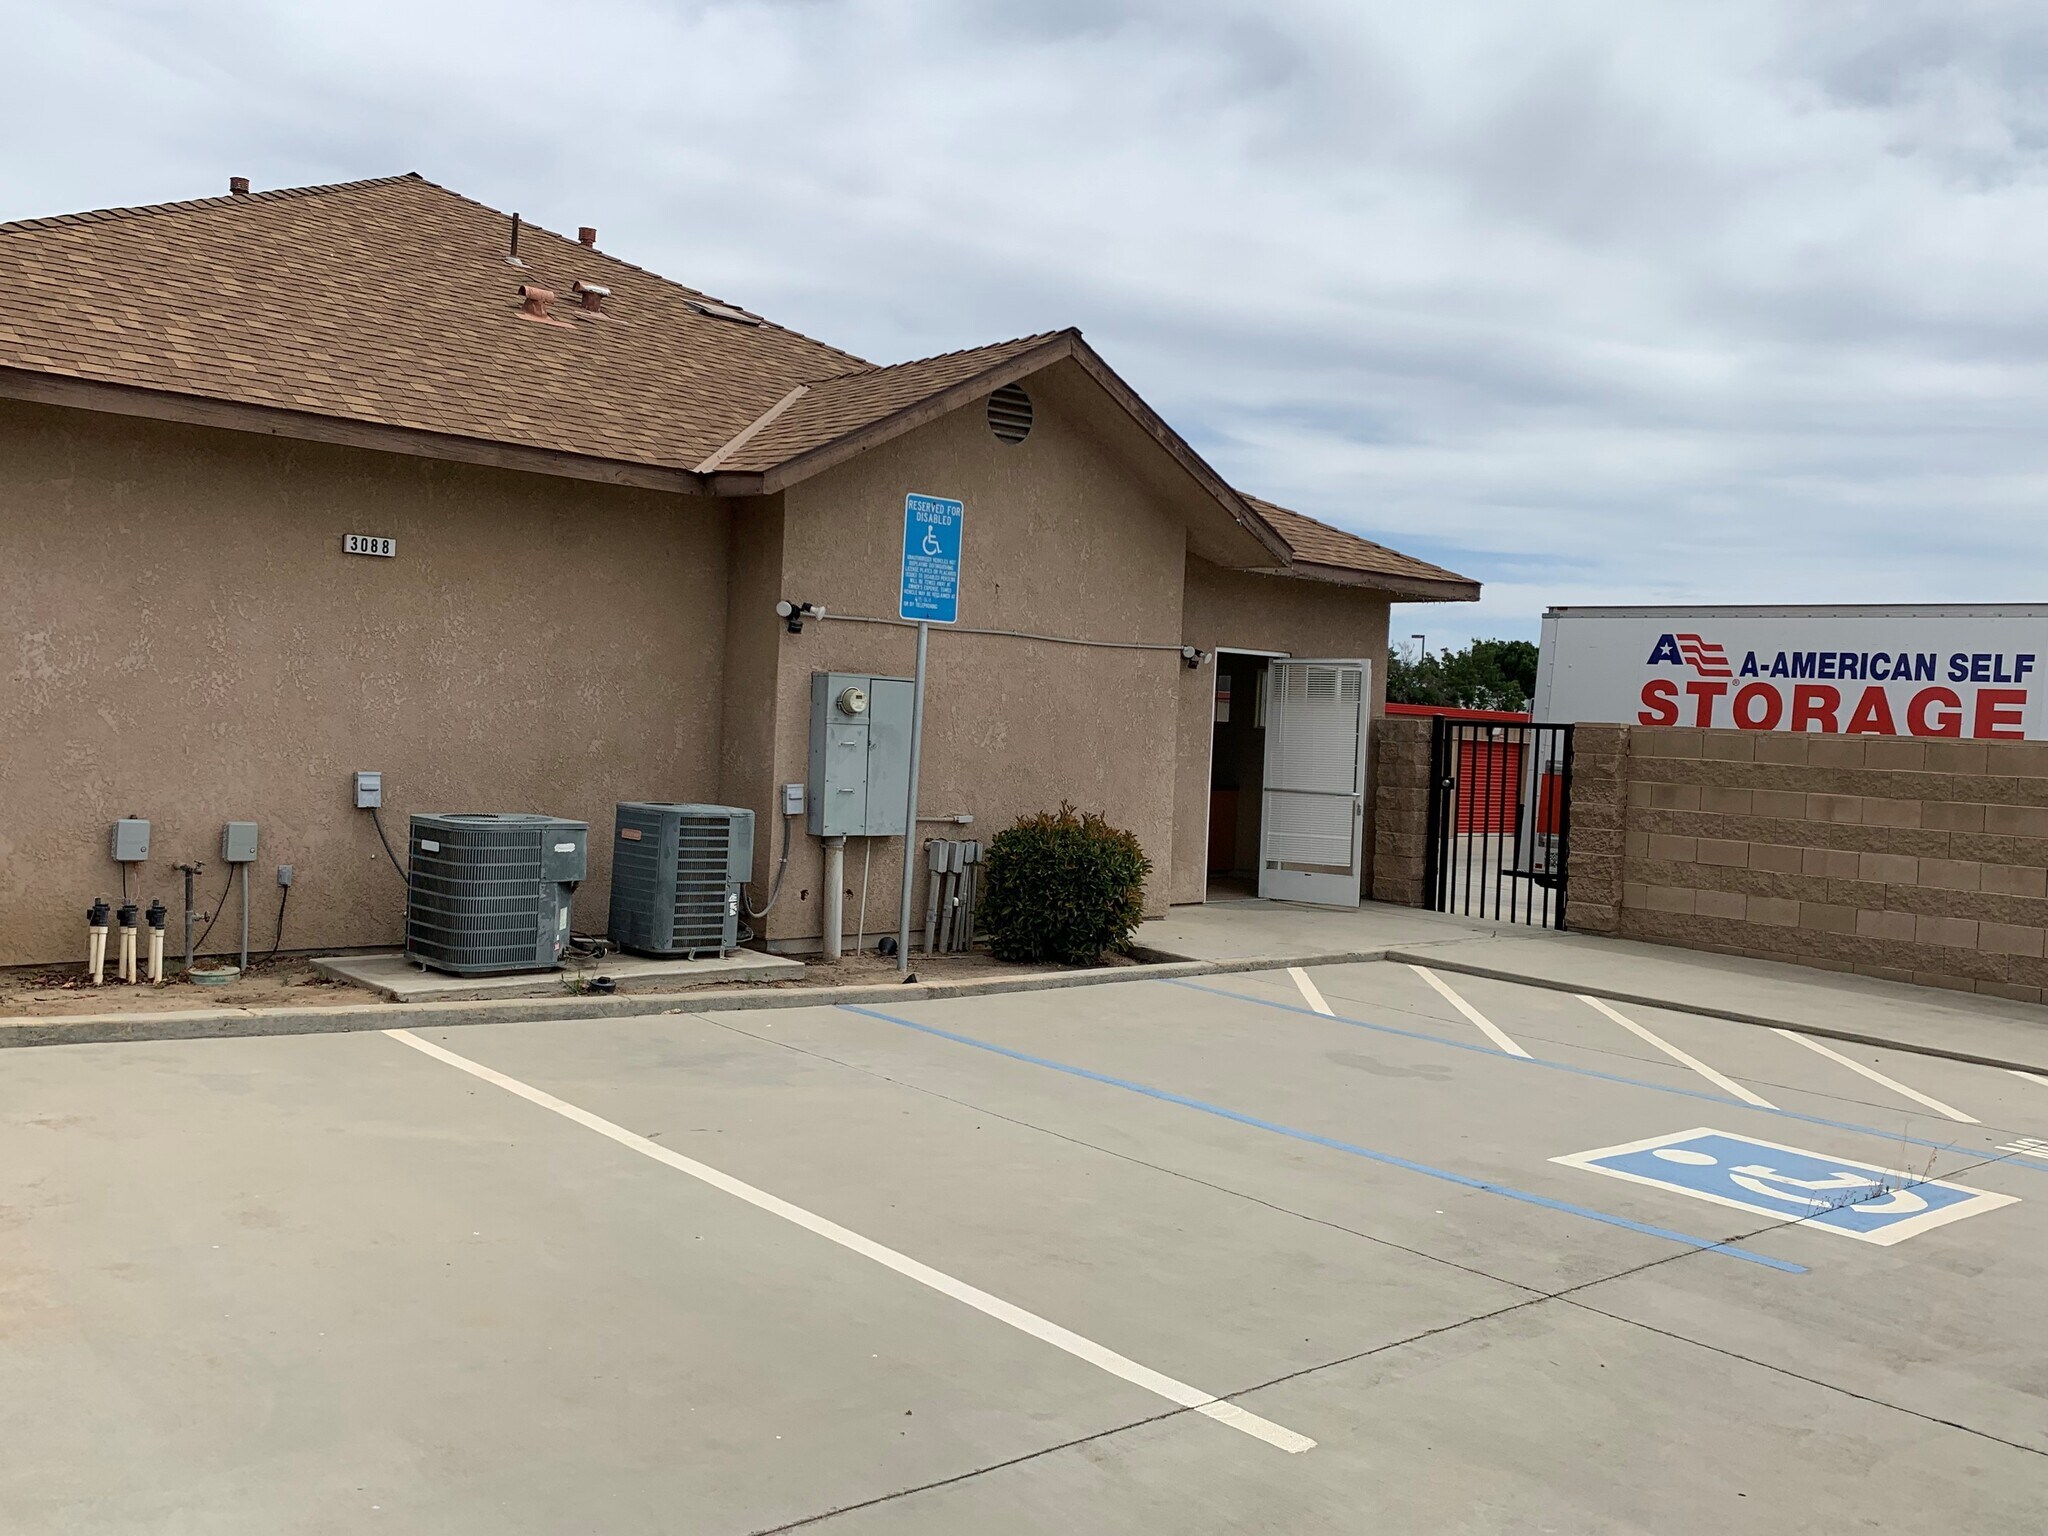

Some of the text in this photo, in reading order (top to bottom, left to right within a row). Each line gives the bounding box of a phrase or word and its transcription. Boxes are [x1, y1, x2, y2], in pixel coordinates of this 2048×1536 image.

[908, 499, 961, 517] RESERVED FOR
[916, 511, 952, 526] DISABLED
[350, 536, 390, 554] 3088
[1739, 650, 2036, 683] A-AMERICAN SELF
[1637, 678, 2028, 740] STORAGE
